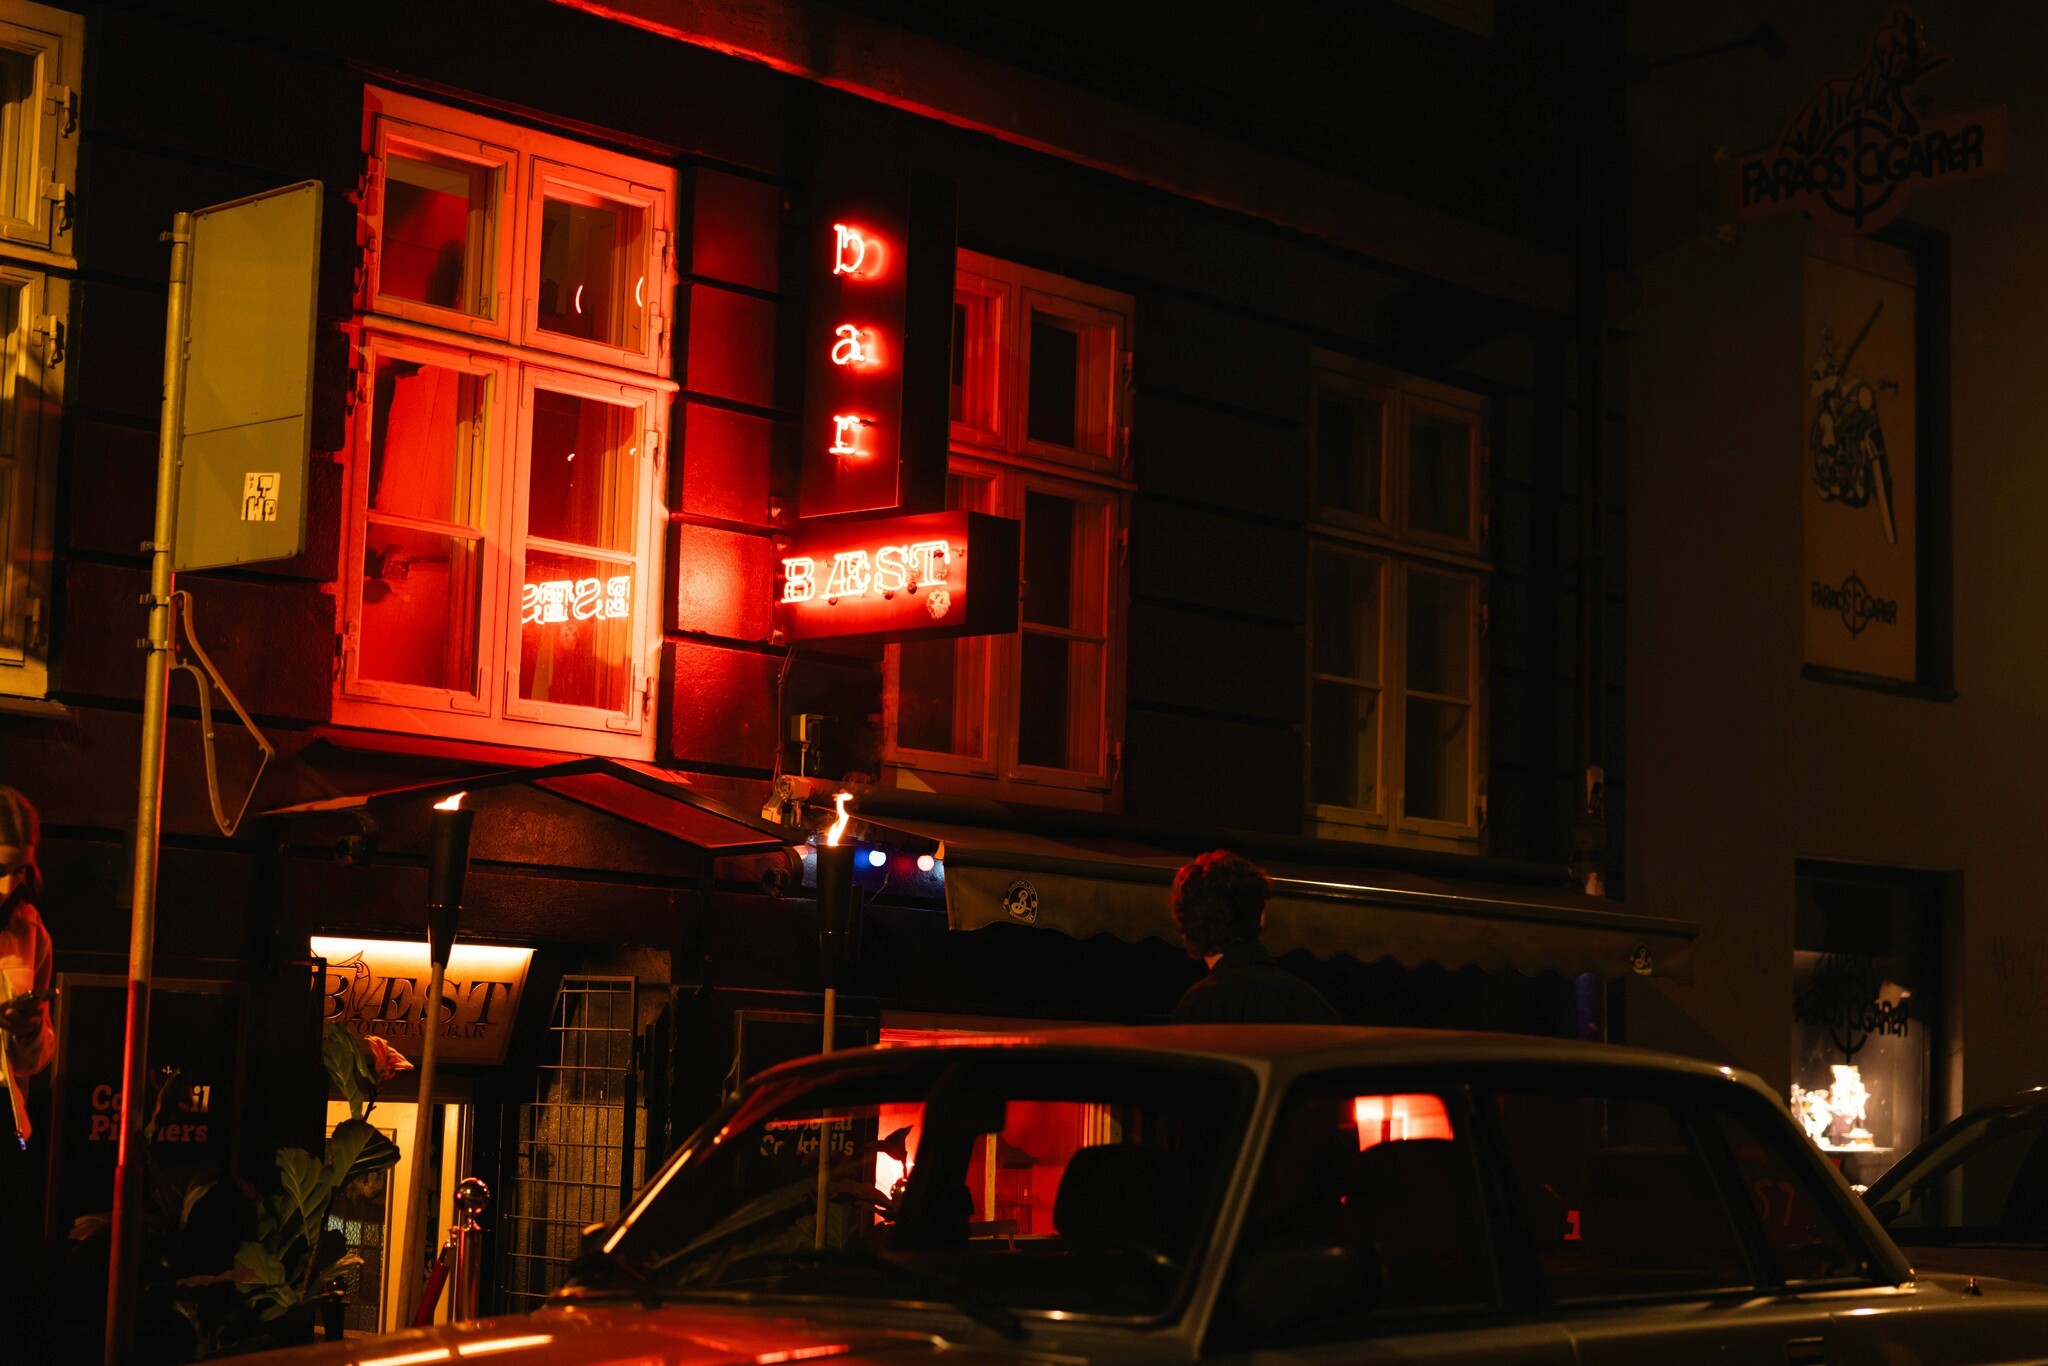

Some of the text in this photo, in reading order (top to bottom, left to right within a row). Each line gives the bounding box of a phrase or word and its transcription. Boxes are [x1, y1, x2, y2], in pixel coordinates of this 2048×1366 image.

[1742, 124, 1985, 206] FARAOS CIGARER
[781, 540, 950, 603] BÆST
